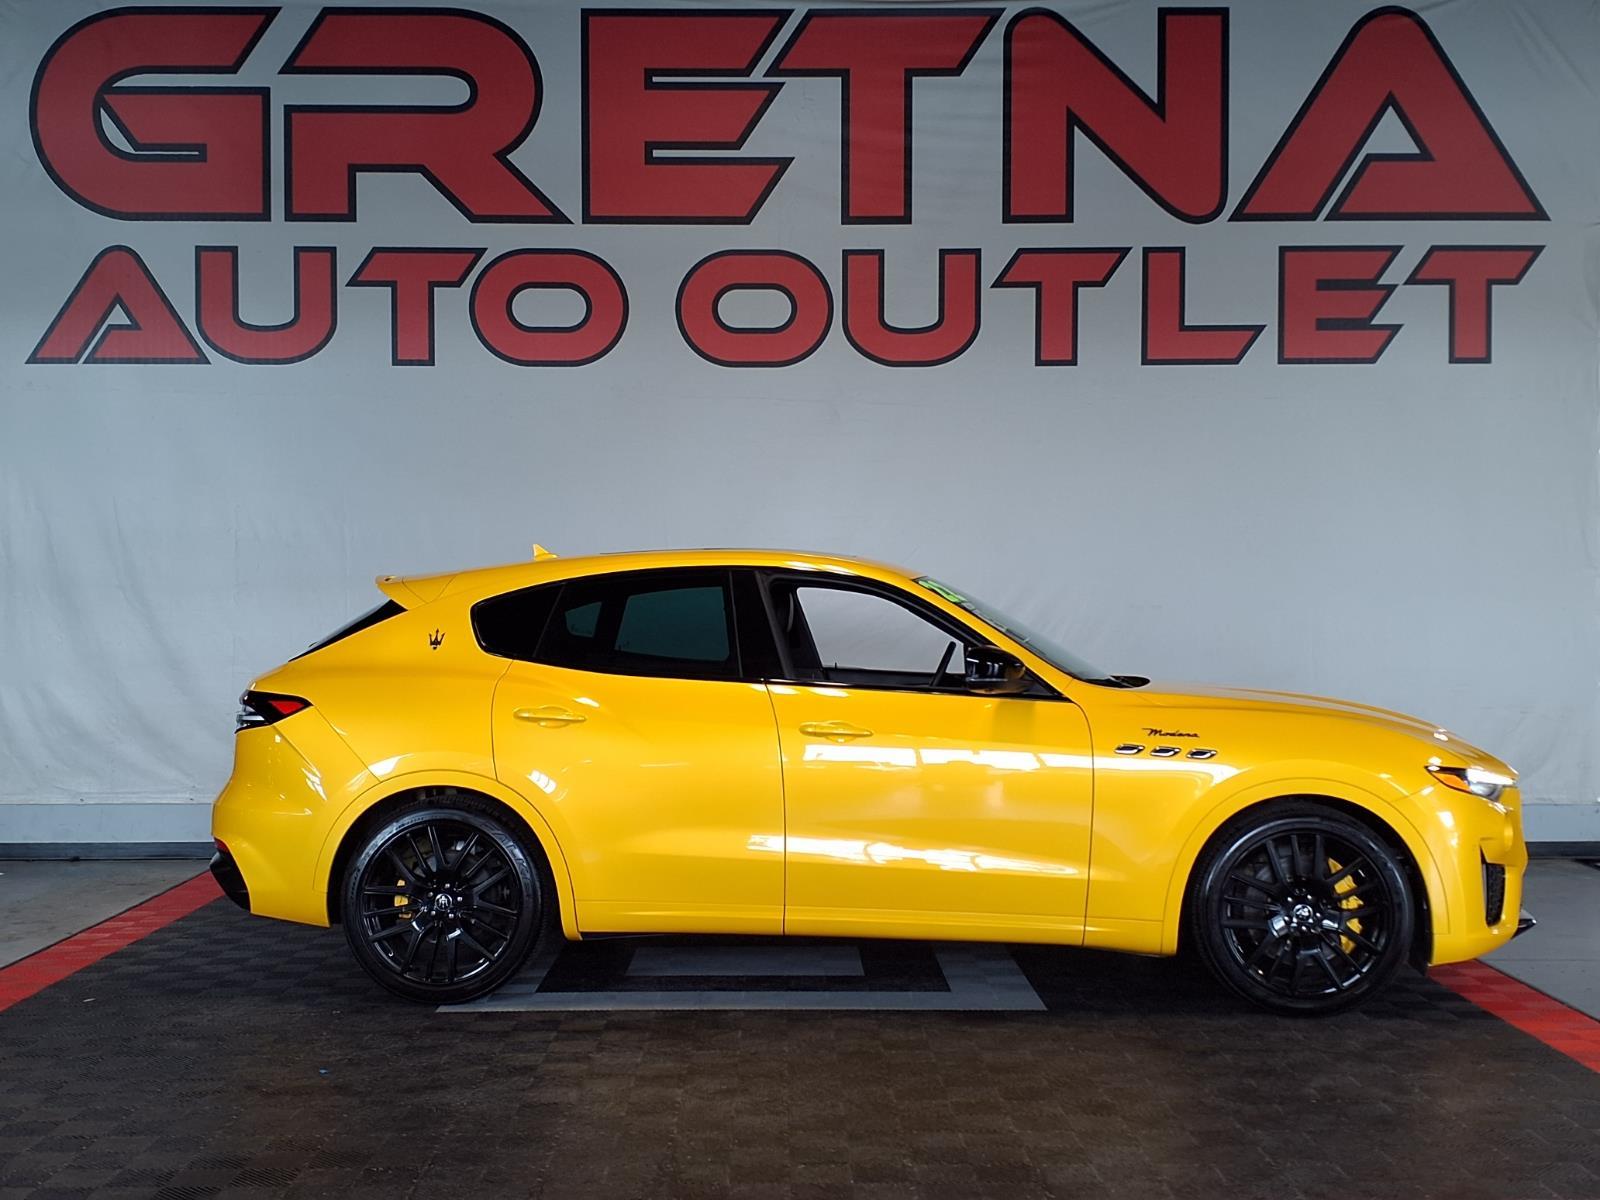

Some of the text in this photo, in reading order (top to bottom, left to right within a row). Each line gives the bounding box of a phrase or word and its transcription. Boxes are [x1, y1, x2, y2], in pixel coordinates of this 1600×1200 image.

[29, 5, 1551, 224] GRETNA
[25, 245, 1547, 367] AUTO OUTLET
